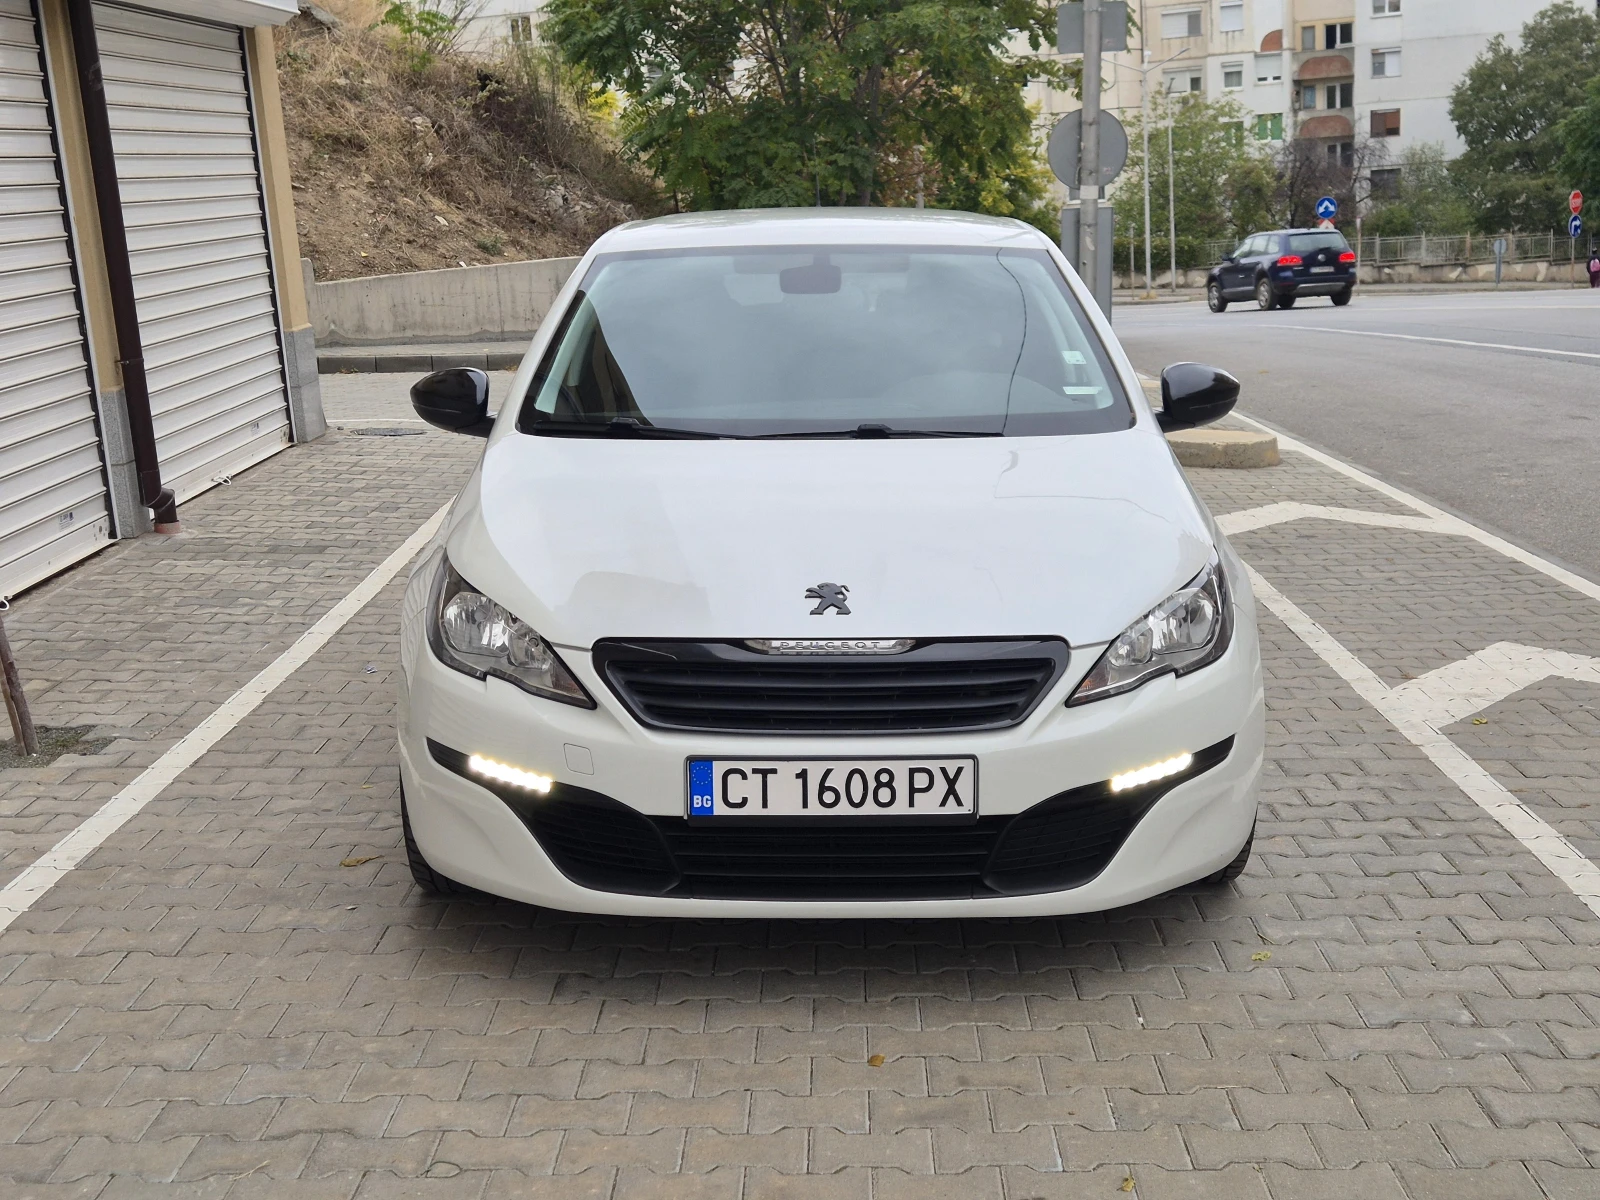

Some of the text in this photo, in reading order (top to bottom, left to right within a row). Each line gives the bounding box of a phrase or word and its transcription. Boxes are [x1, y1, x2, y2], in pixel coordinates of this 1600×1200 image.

[779, 641, 881, 650] PEUGEOT
[721, 766, 965, 809] CT 1608 PX
[693, 795, 712, 808] BG
